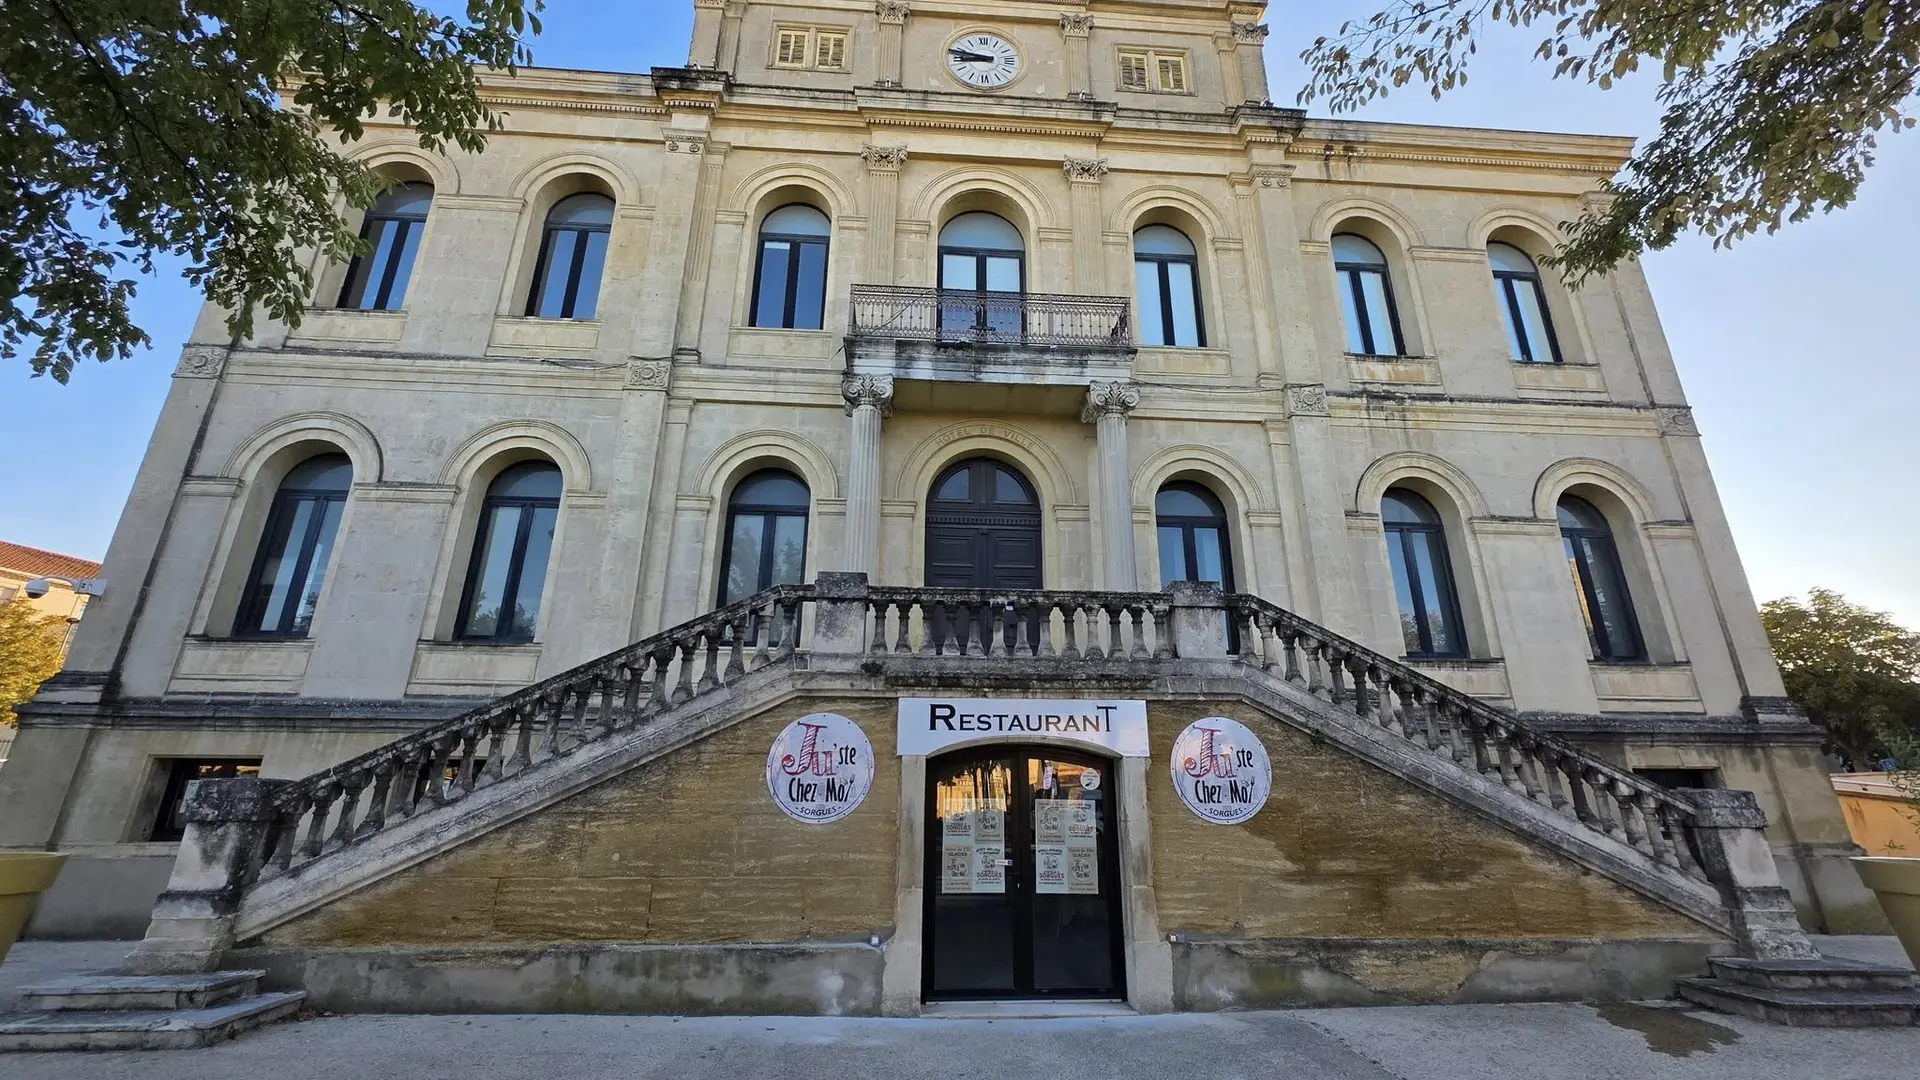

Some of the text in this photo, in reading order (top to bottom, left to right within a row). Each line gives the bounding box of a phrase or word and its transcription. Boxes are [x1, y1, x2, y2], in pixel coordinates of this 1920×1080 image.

[980, 426, 996, 435] DE
[1004, 429, 1034, 451] VILLE
[929, 703, 1118, 733] RESTAURANT
[788, 777, 818, 803] Chez
[1194, 779, 1223, 804] Chez
[800, 805, 837, 817] SORGUES
[1208, 807, 1244, 818] SORGUES
